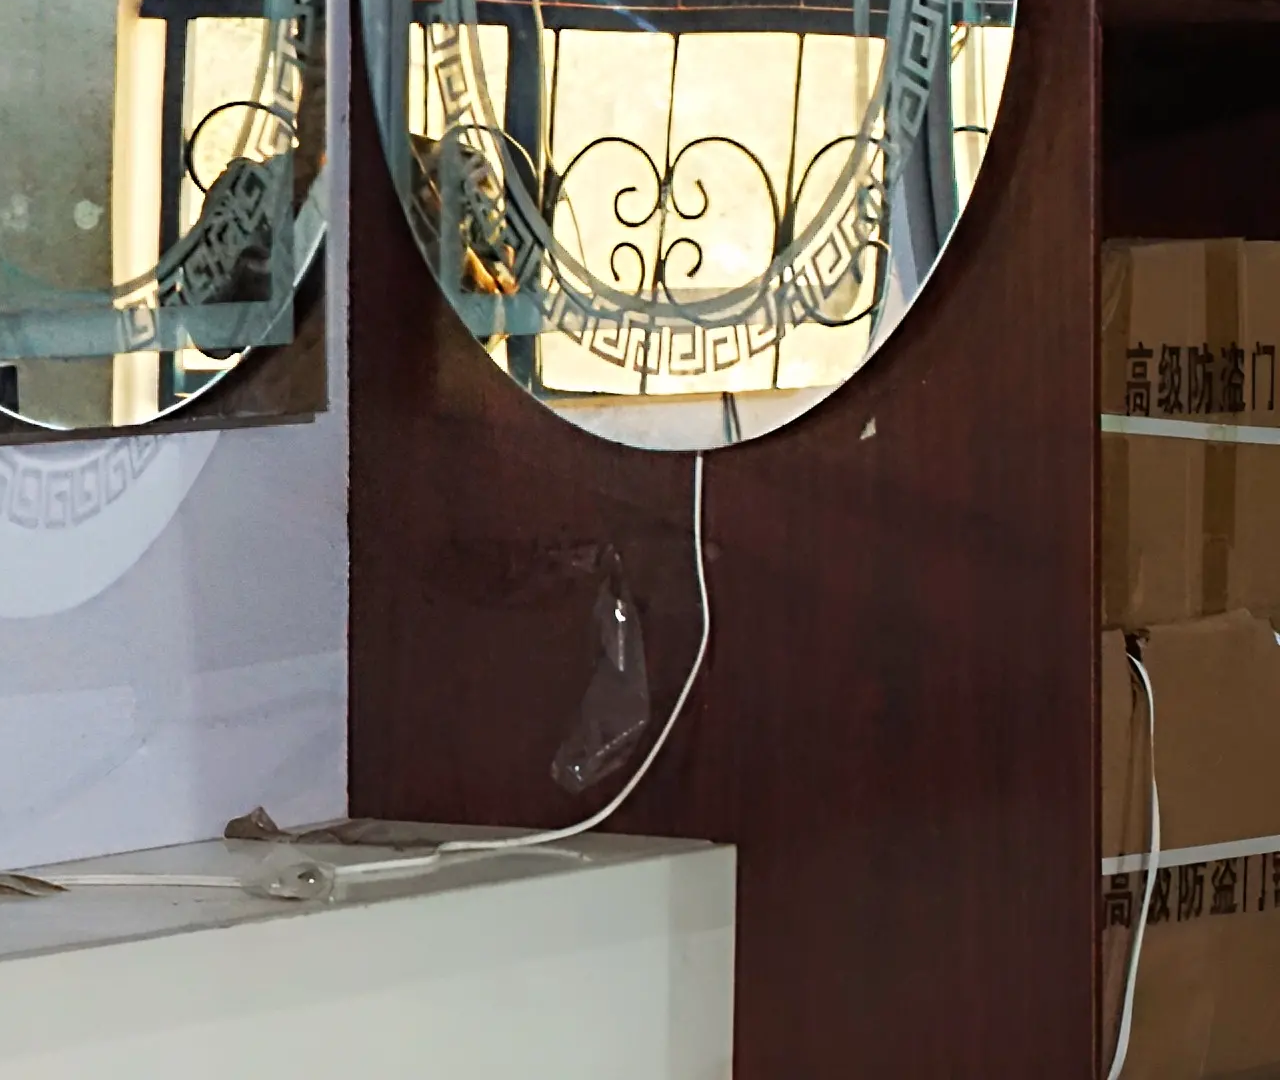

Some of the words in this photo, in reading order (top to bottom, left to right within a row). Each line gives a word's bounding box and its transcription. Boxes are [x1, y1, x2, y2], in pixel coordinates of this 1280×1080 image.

[1125, 341, 1276, 417] 高级防盗门
